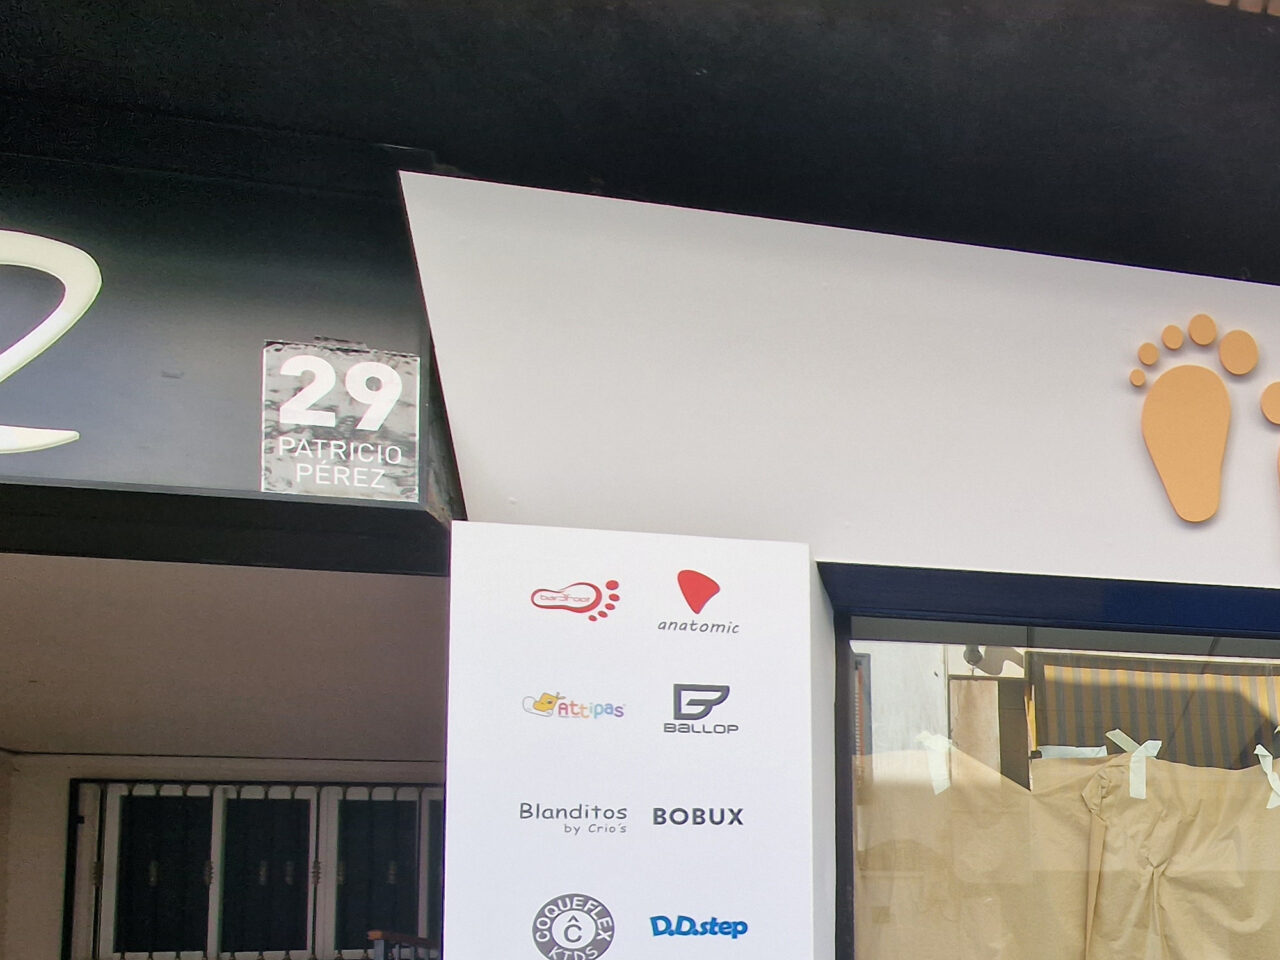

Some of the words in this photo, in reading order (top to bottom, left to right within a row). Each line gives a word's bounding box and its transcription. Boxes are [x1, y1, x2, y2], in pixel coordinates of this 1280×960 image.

[279, 354, 402, 431] 29
[279, 437, 402, 465] PATRICIO
[296, 459, 386, 489] PÉREZ
[657, 619, 740, 634] anatomic
[557, 700, 625, 719] Attipas
[519, 802, 628, 820] Blanditos
[652, 807, 744, 826] BOBUX
[564, 823, 581, 836] by
[535, 896, 613, 942] COQUEFLEX
[649, 915, 748, 939] D.D.step
